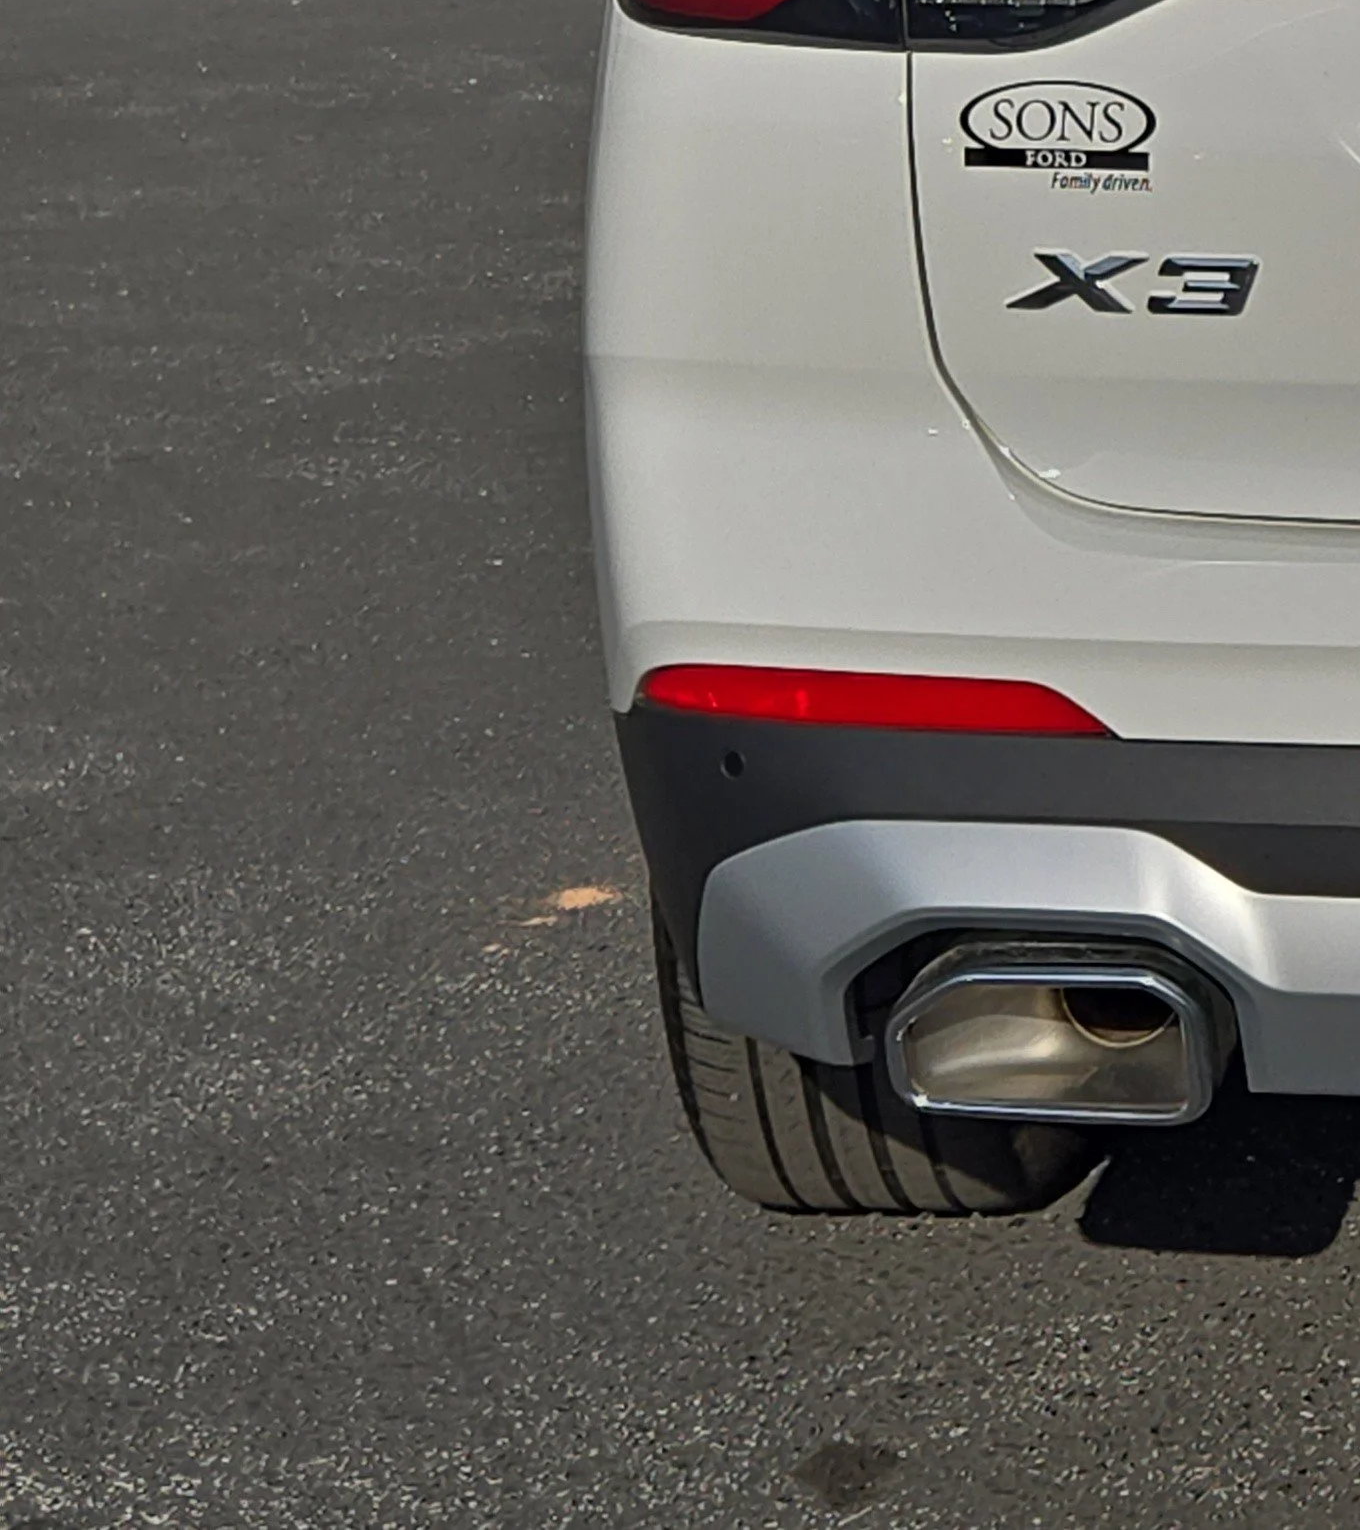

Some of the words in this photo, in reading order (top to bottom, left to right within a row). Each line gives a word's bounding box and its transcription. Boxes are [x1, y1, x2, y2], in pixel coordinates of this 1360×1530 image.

[988, 98, 1126, 144] SONS
[1024, 150, 1087, 168] FORD
[1051, 171, 1101, 193] Family
[1103, 173, 1153, 192] driven.
[1005, 247, 1261, 316] X3
